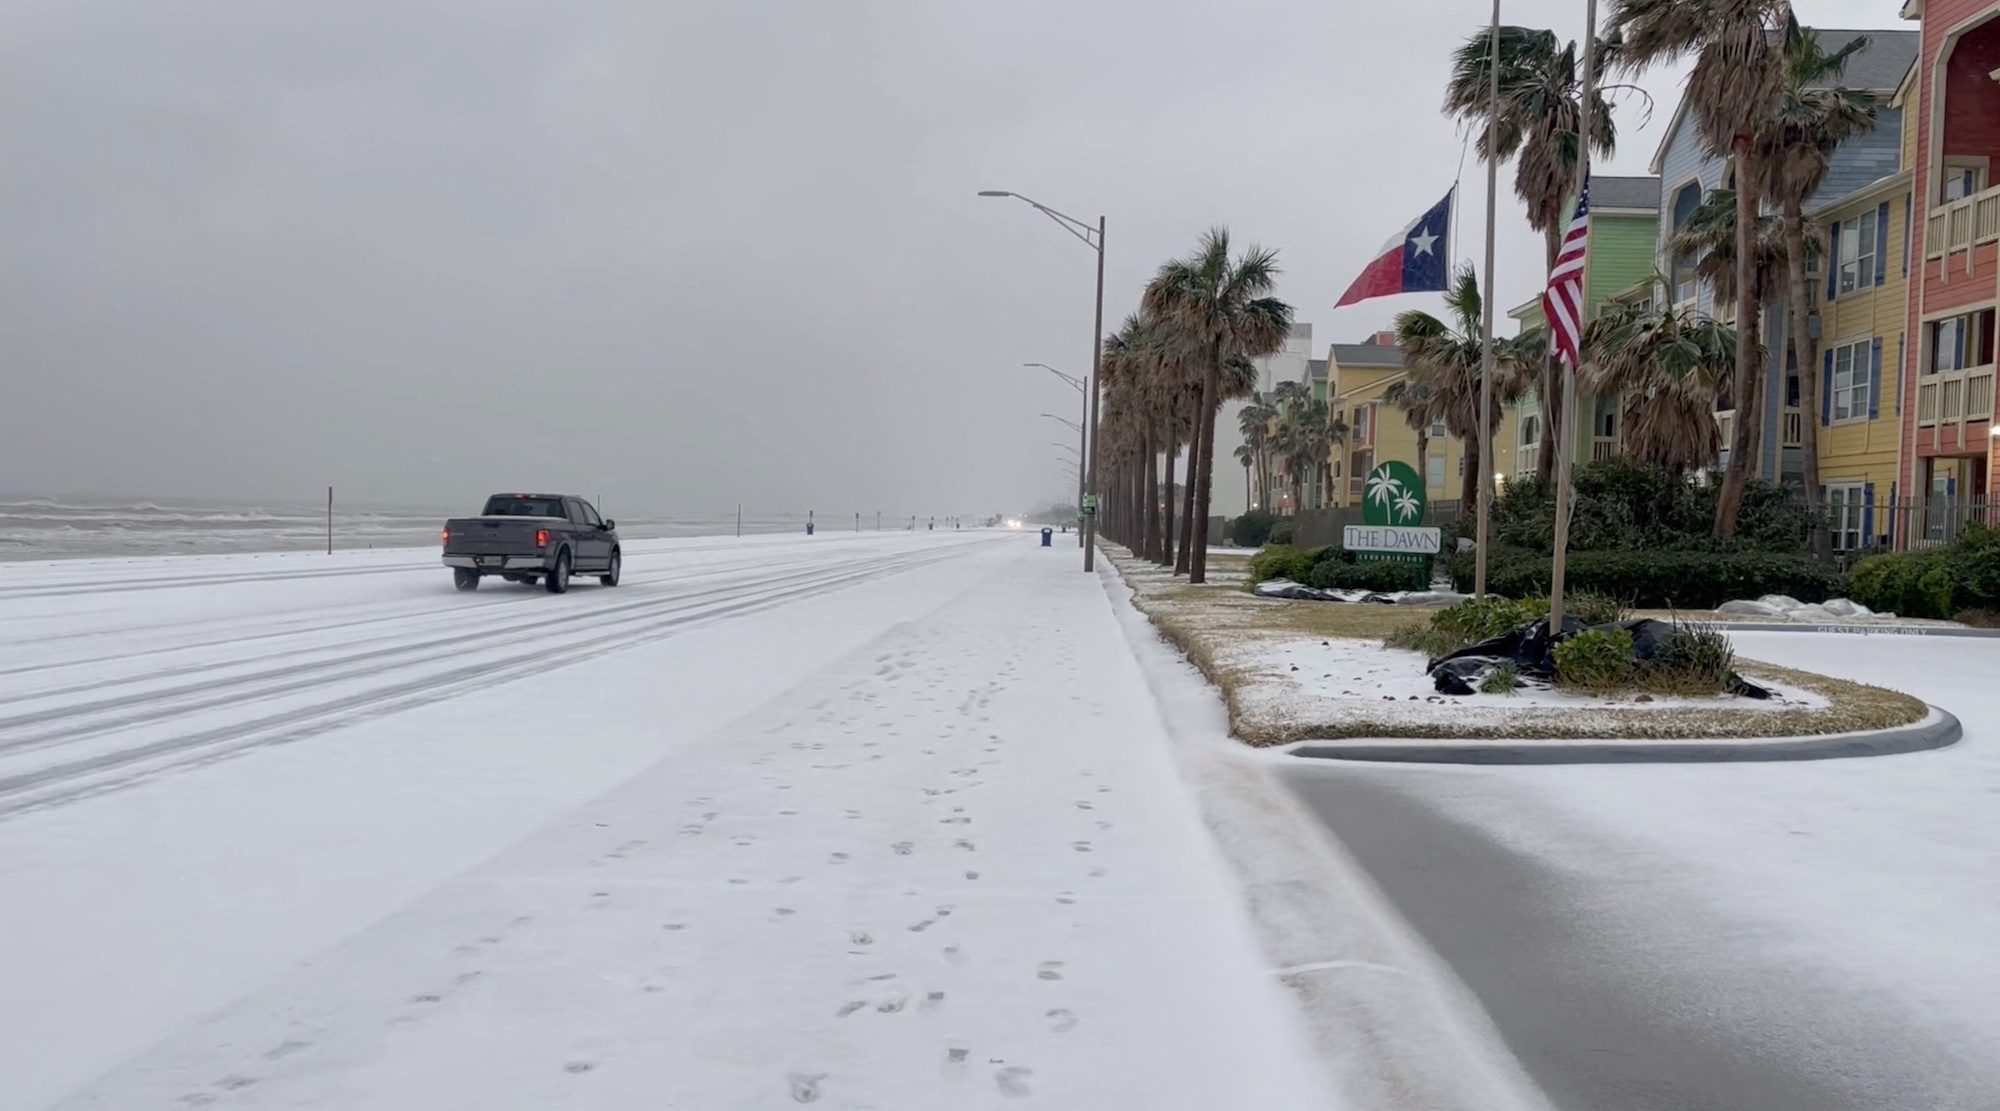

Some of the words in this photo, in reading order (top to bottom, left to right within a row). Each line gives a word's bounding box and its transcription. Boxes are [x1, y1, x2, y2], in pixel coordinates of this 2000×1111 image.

[1346, 527, 1379, 547] THE
[1384, 529, 1438, 549] DAWN
[1817, 626, 1849, 634] GUEST
[1853, 626, 1898, 636] PARKING
[1900, 628, 1928, 636] ONLY
